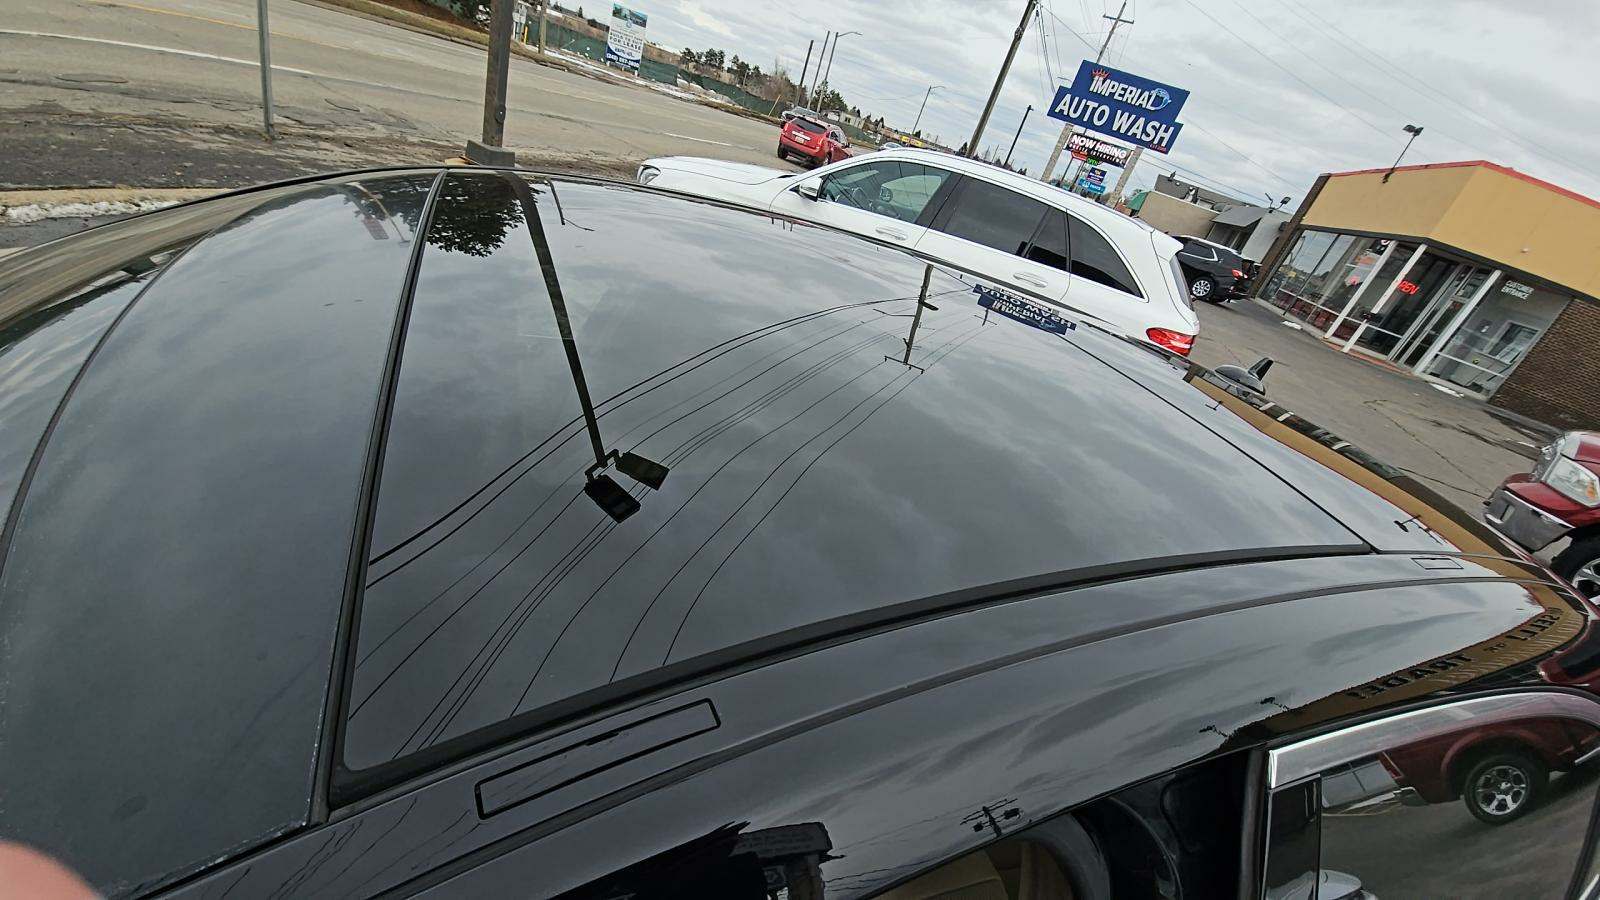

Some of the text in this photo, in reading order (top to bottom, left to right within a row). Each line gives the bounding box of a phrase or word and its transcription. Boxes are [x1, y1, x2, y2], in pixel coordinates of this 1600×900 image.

[609, 35, 621, 43] FOR
[623, 41, 641, 50] LEASE
[1089, 75, 1157, 111] IMPERIAL
[1054, 93, 1175, 148] AUTO WASH
[1071, 134, 1097, 149] NOW
[1094, 142, 1127, 159] HIRING
[1398, 280, 1420, 295] PEN
[1501, 285, 1530, 300] ENTRANCE
[1505, 280, 1535, 294] CUSTOMER
